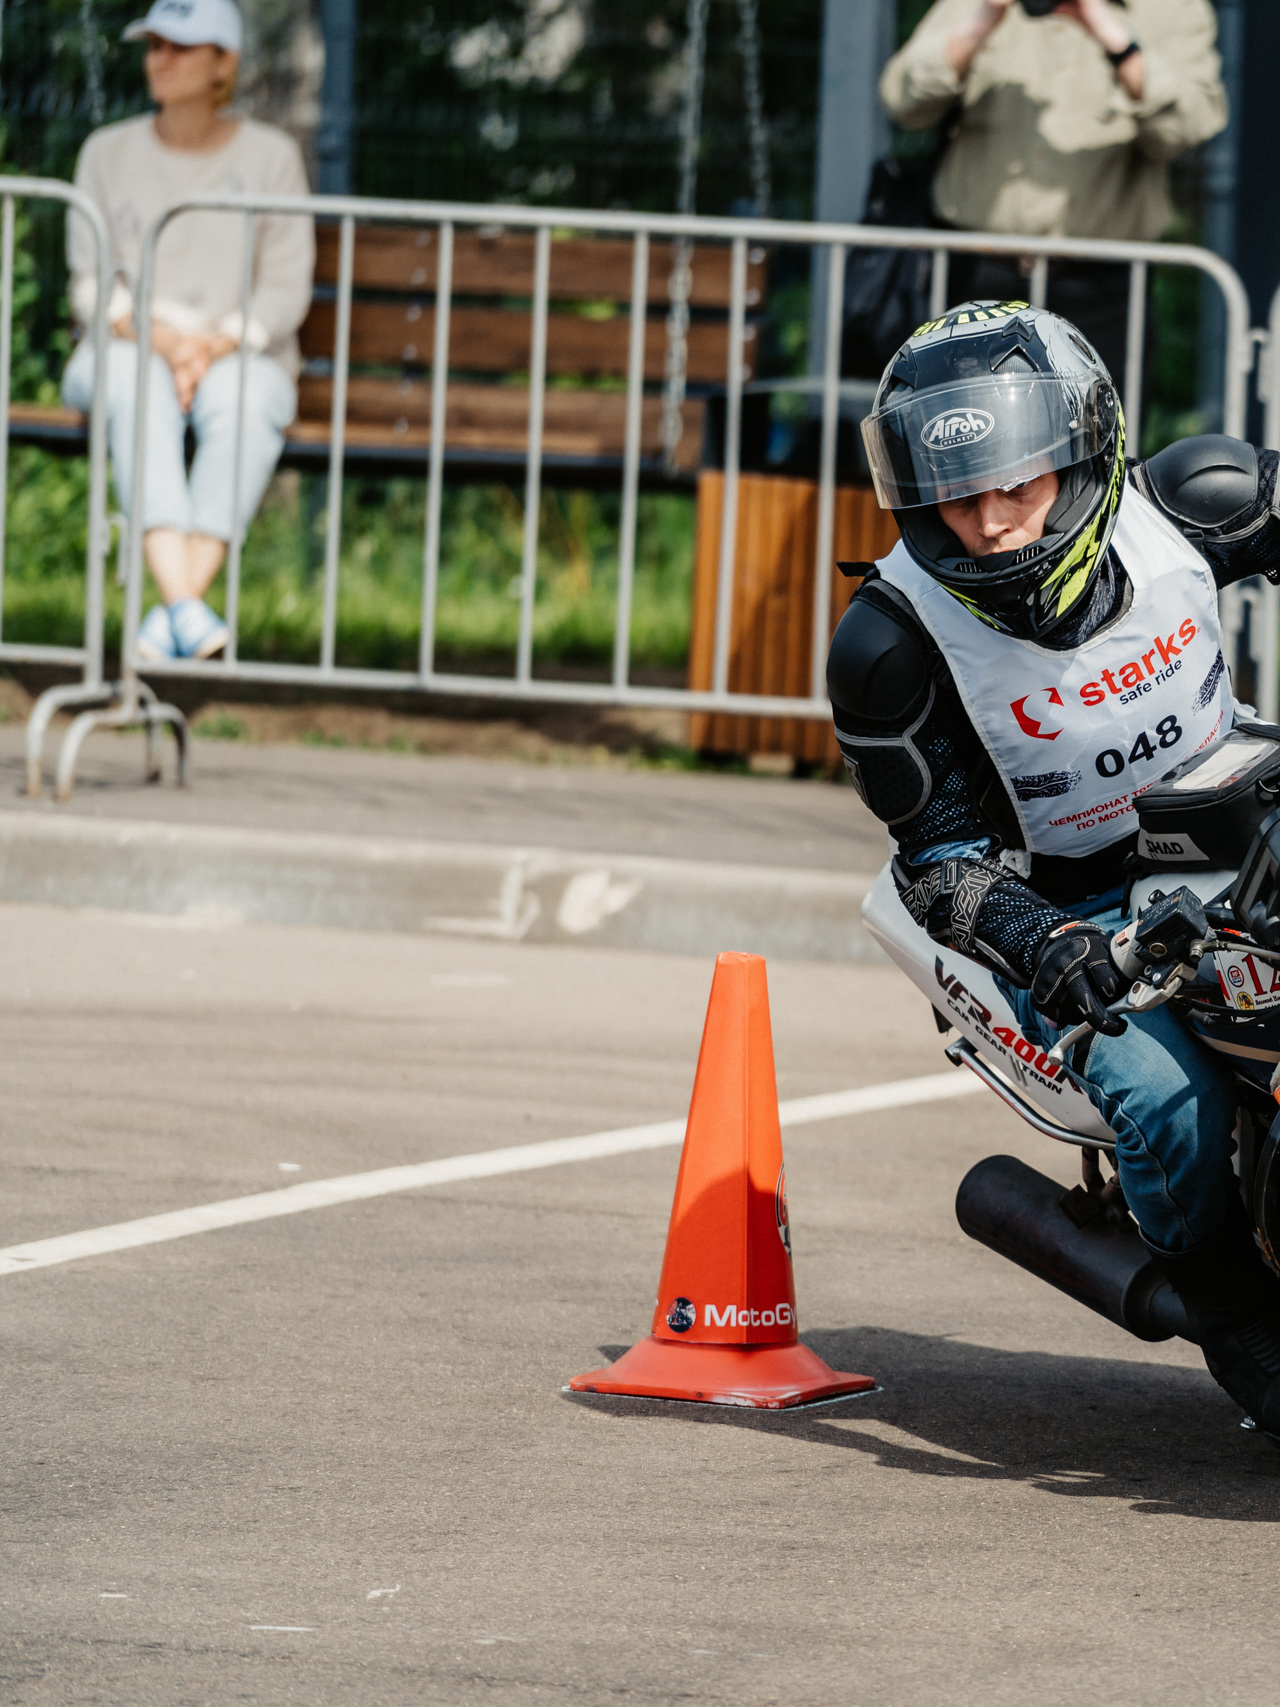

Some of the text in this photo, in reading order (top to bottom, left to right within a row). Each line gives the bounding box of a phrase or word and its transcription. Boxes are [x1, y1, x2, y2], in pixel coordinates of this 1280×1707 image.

[1079, 618, 1197, 707] starks
[1119, 659, 1183, 705] safe ride
[1095, 714, 1183, 778] 048
[1048, 795, 1129, 827] ЧЕМПИОНАТ
[1076, 803, 1136, 831] ПО МОТО
[1145, 838, 1185, 855] SHAD
[947, 998, 1063, 1096] CAM GEAR TRAIN
